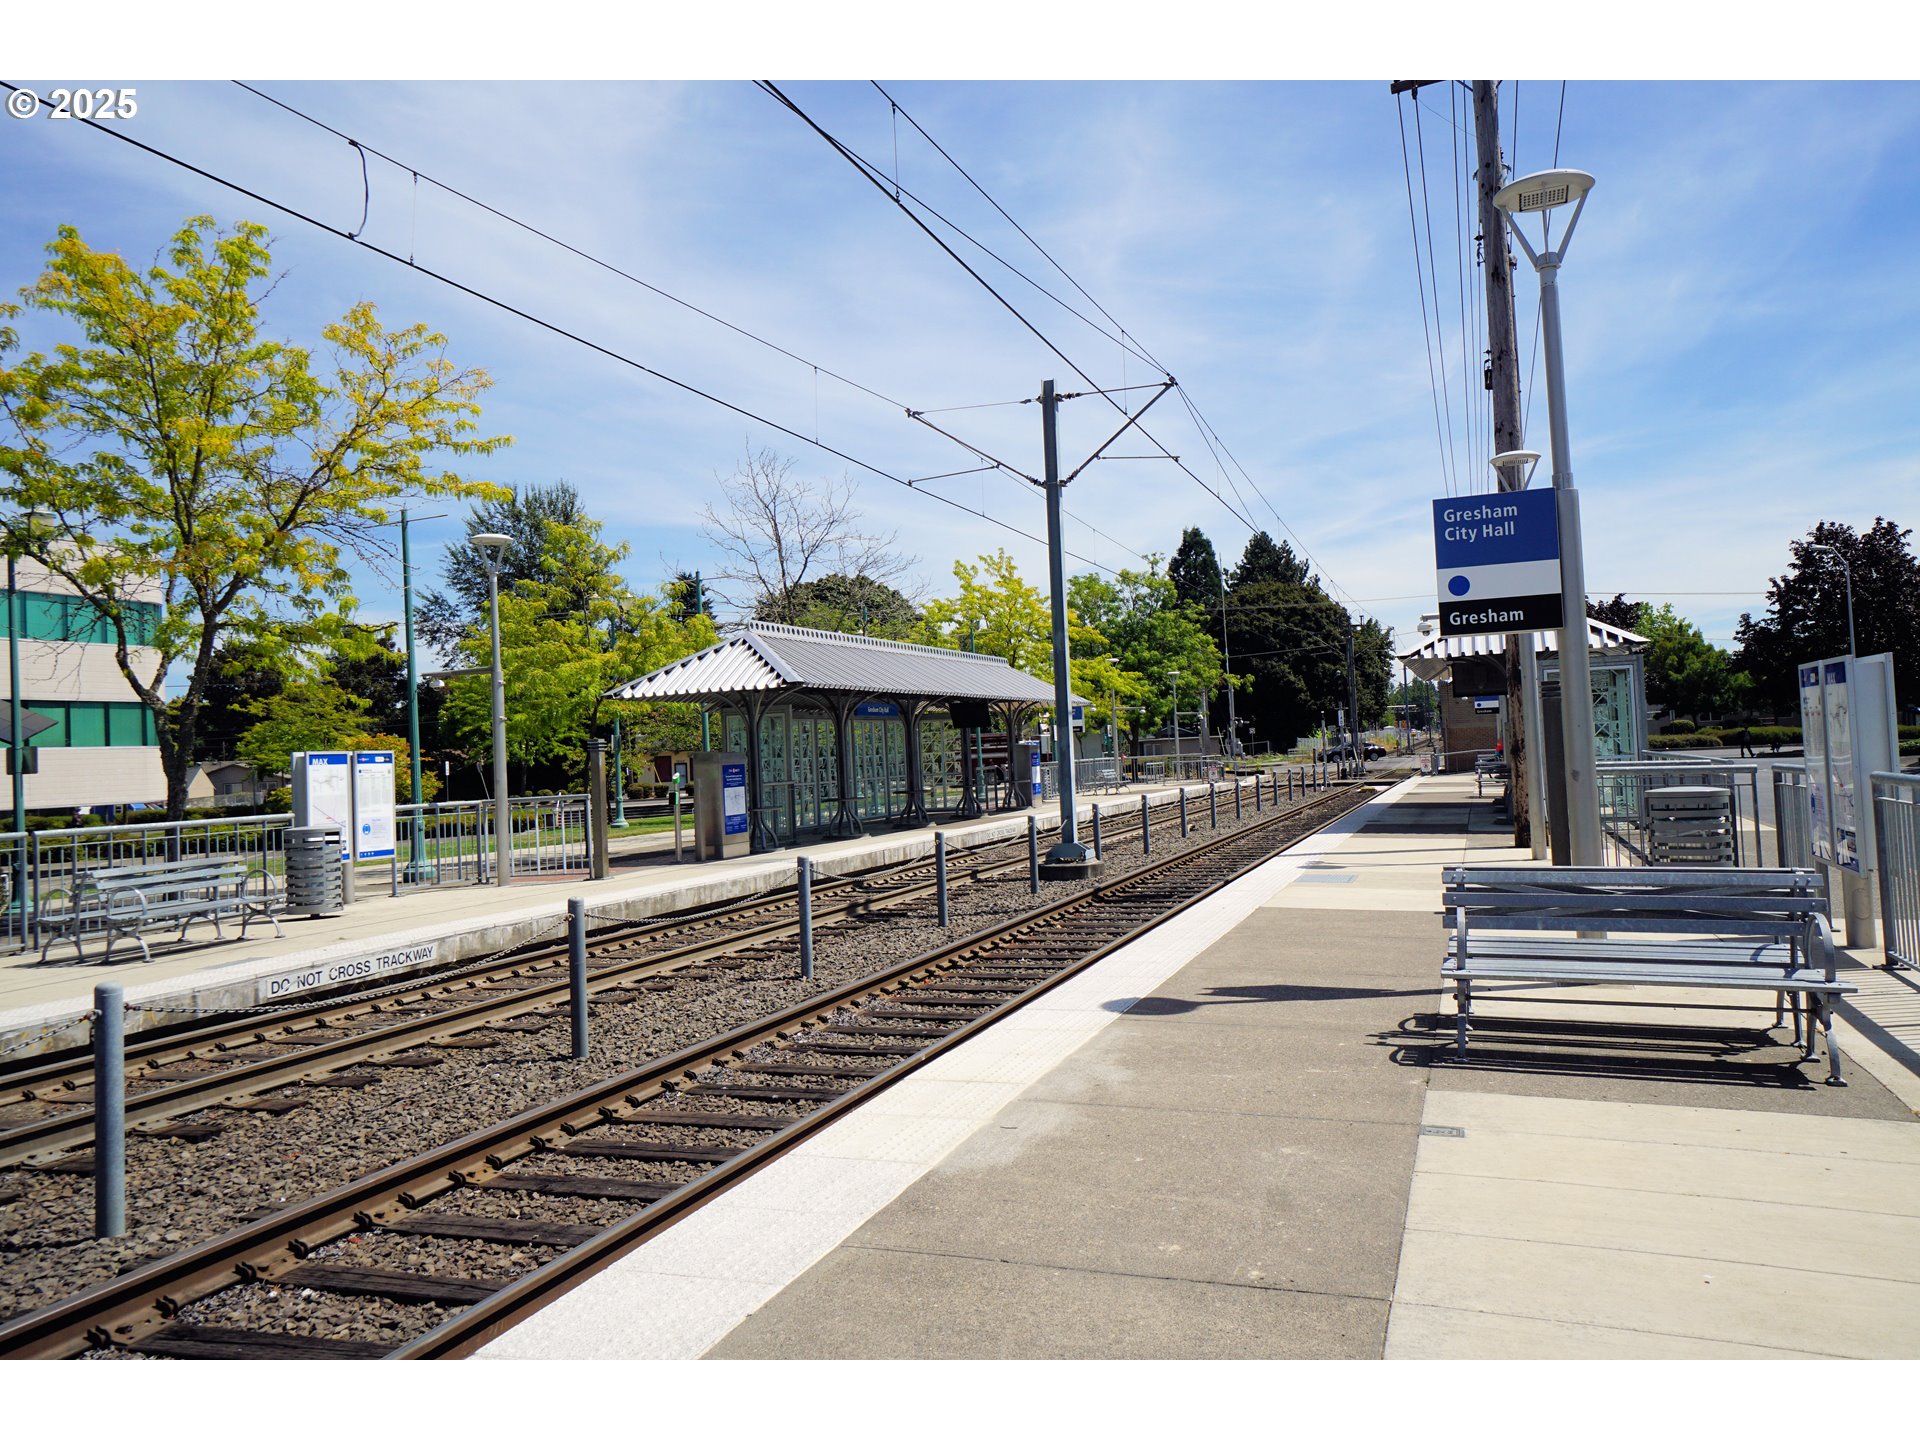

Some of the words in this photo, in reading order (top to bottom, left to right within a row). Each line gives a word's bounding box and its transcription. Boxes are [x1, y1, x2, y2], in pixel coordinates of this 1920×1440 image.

[1443, 505, 1518, 523] Gresham
[1445, 527, 1477, 543] City
[1483, 521, 1515, 538] Hall
[1449, 609, 1525, 626] Gresham
[312, 758, 329, 766] MAX
[271, 979, 290, 994] DO
[297, 971, 323, 989] NOT
[329, 960, 371, 981] CROSS
[376, 946, 434, 970] TRACKWAY
